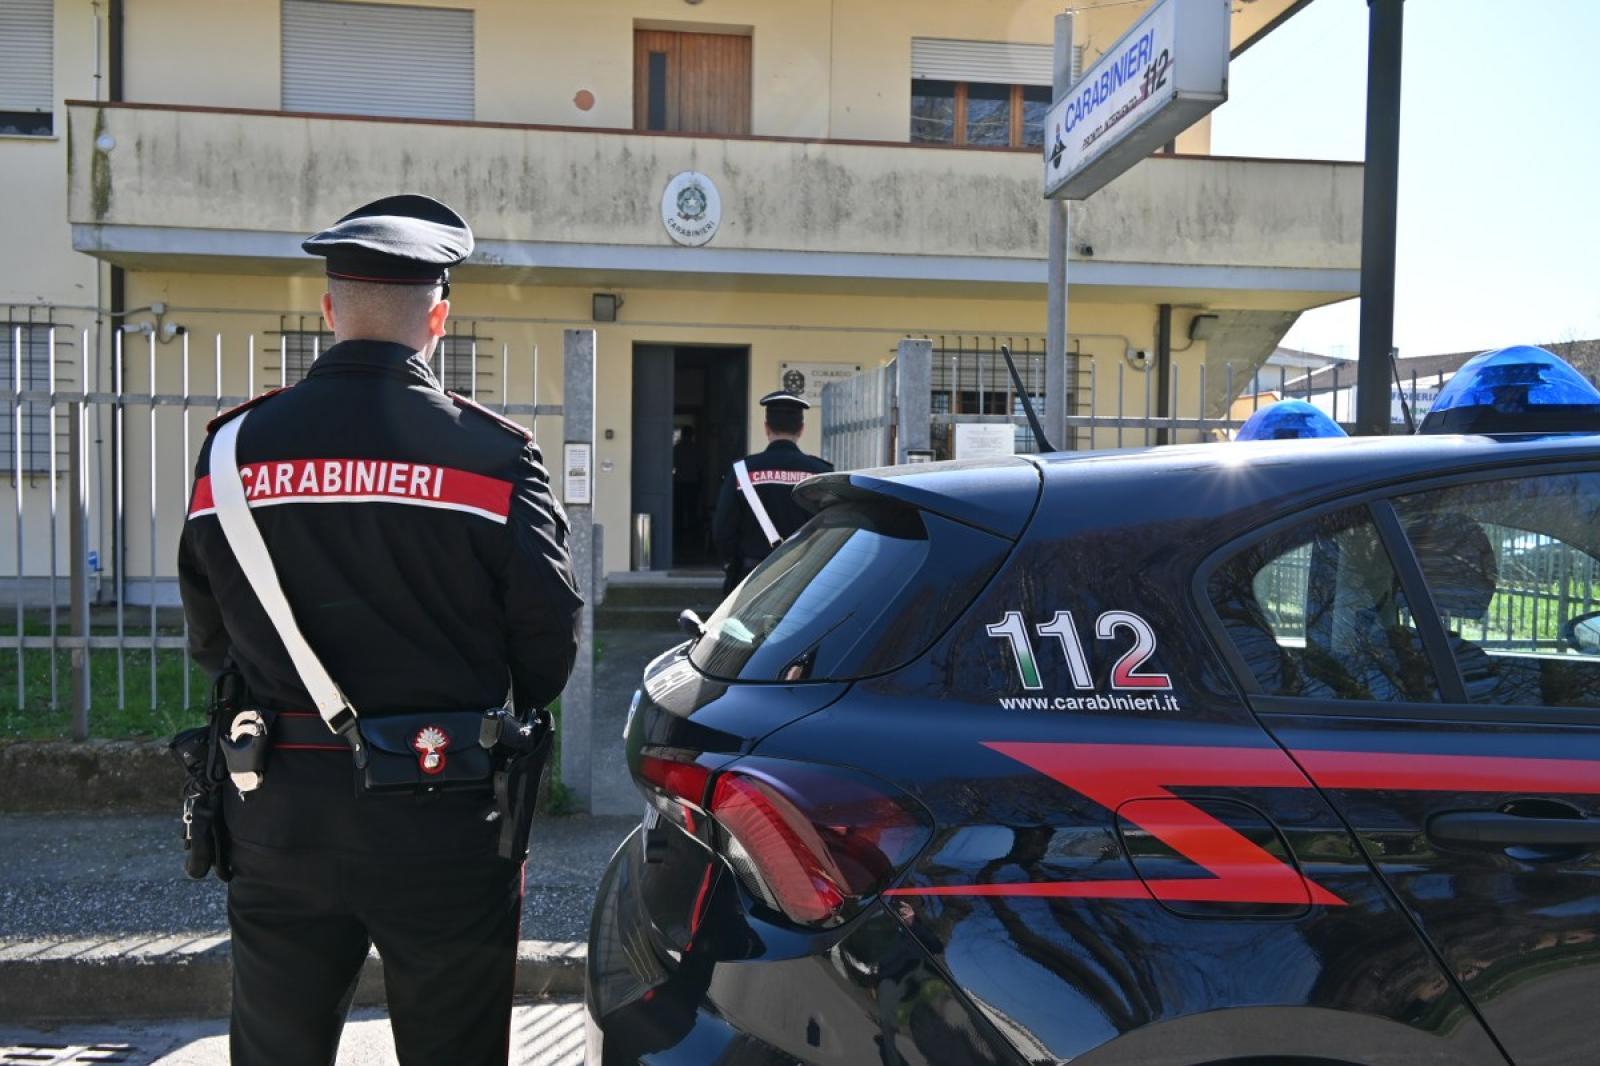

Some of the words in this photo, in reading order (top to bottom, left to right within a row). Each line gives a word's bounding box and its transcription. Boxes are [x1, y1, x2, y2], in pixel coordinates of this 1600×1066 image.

[1065, 28, 1154, 133] CARABINIERI
[1143, 48, 1168, 100] 112
[667, 217, 715, 237] CARABINIERI
[986, 611, 1173, 690] 112
[1000, 695, 1180, 711] www.carabinieri.it
